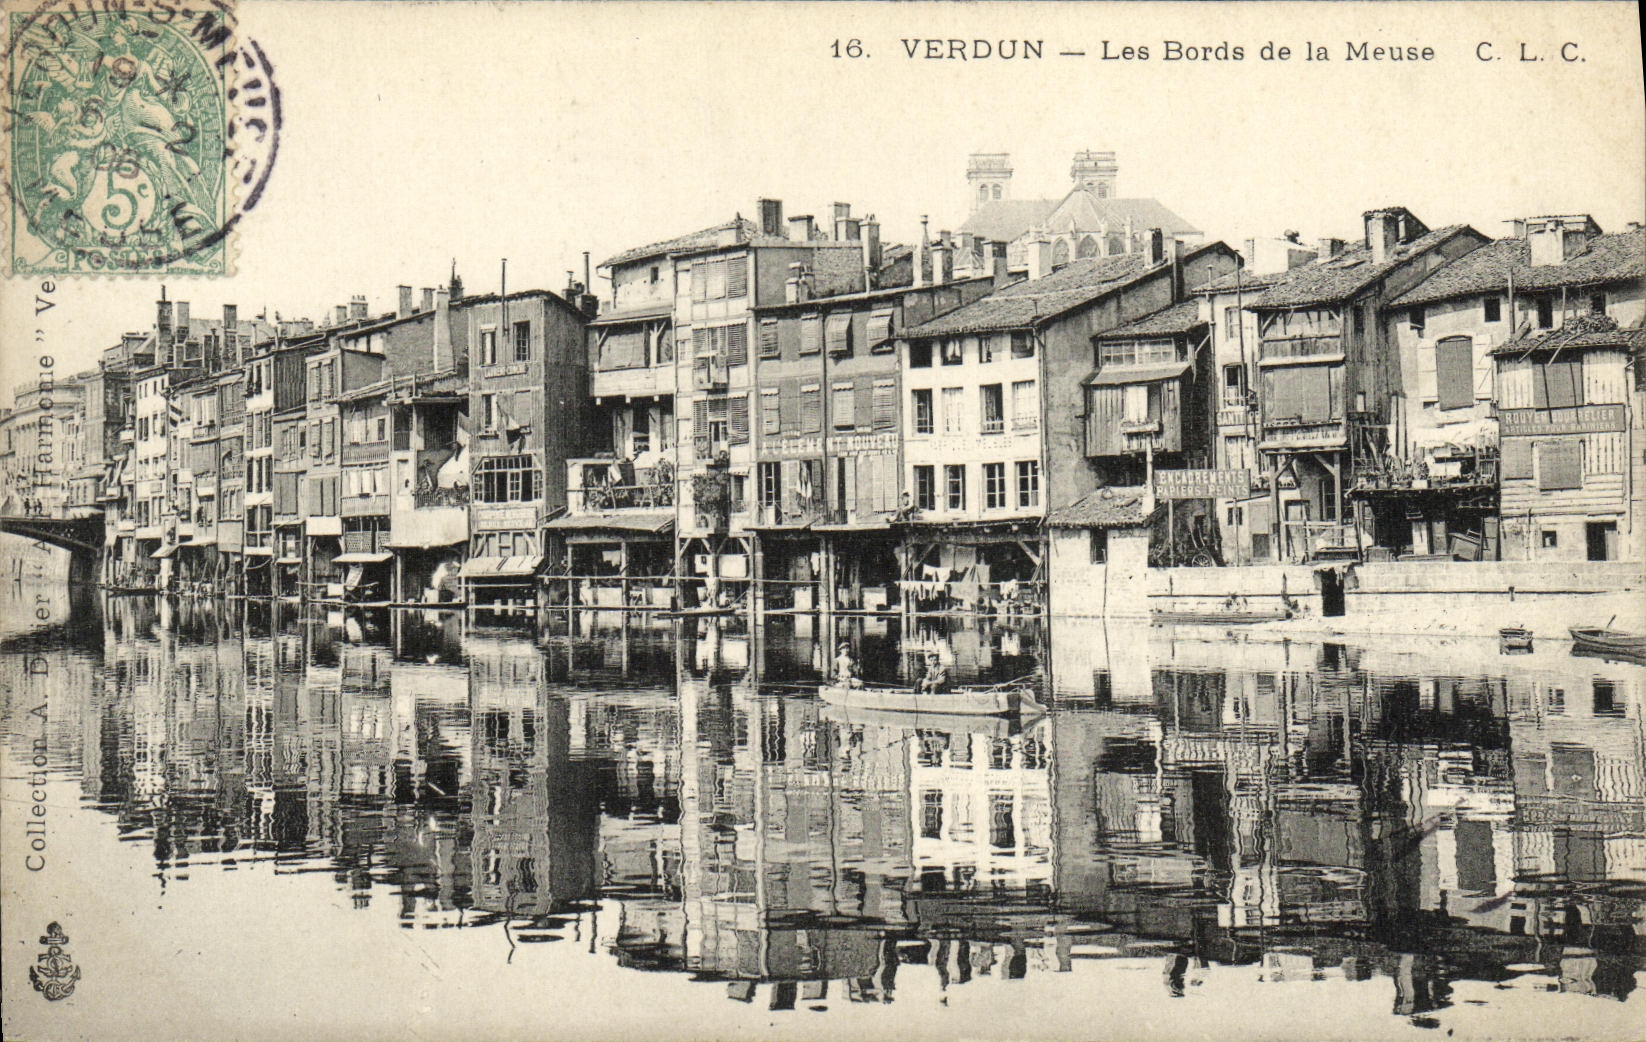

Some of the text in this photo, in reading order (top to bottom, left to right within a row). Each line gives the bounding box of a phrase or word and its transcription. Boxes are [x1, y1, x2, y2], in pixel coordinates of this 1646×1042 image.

[71, 249, 165, 271] POSTES
[1551, 409, 1615, 424] BOURRELIER
[1159, 471, 1244, 484] ENCADREMENTS
[1156, 484, 1248, 497] PAPIERS PEINTS
